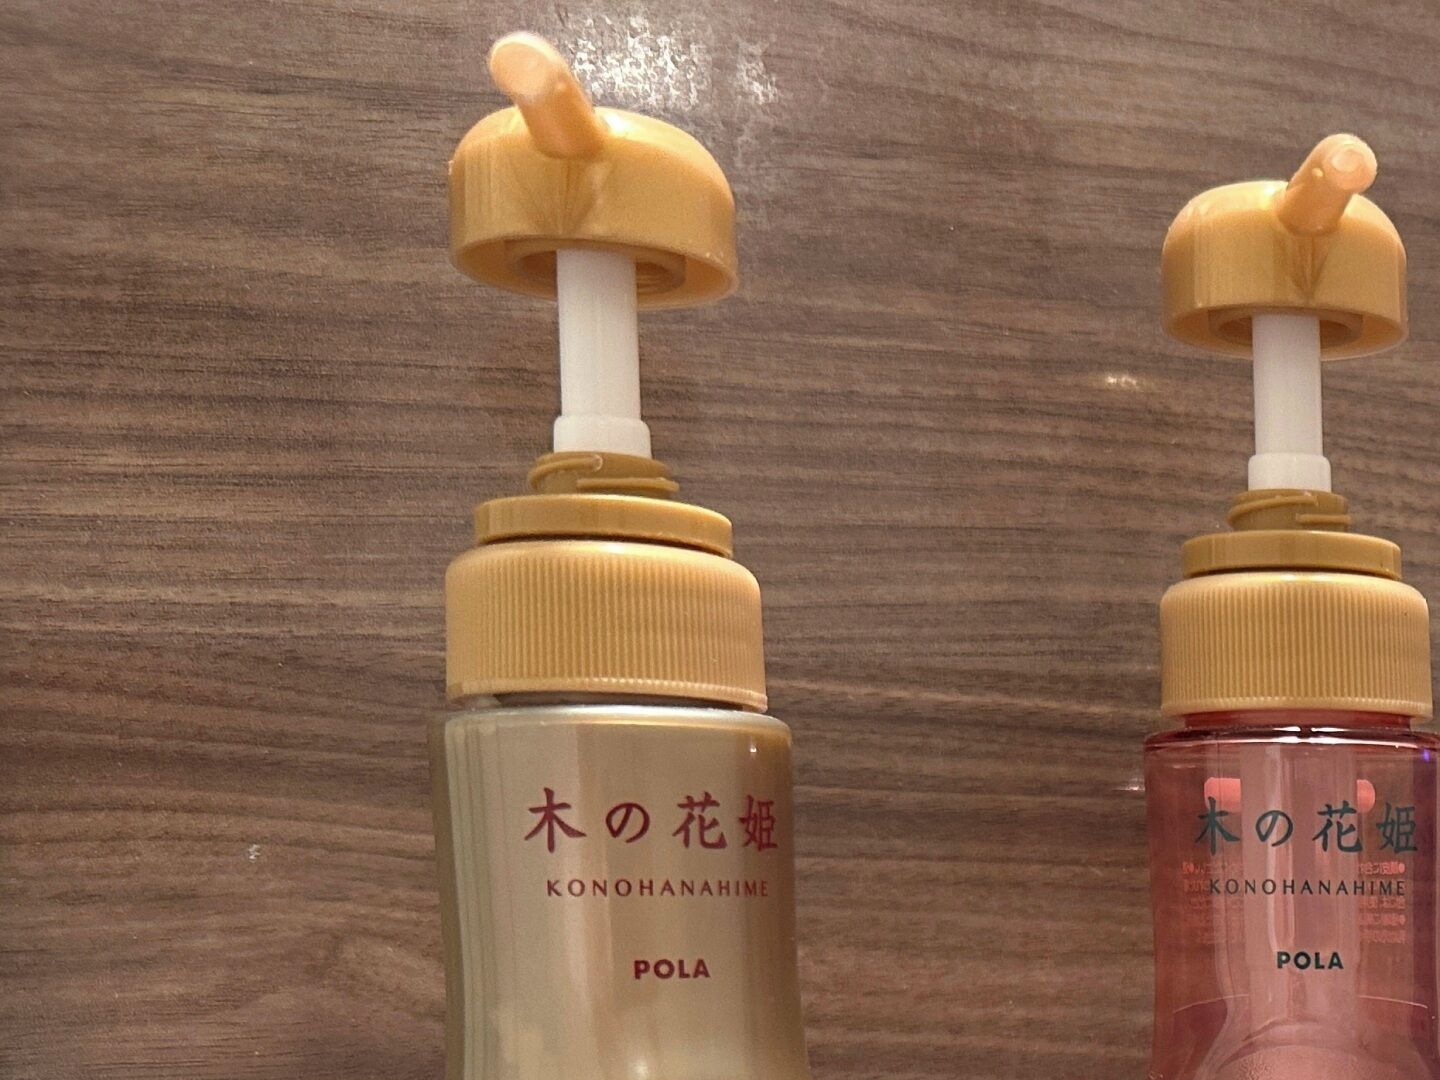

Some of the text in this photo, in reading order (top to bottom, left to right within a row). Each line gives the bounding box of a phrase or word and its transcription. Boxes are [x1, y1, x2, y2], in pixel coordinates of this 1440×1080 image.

[524, 787, 779, 853] 木の花姫
[1194, 796, 1418, 855] 木の花姫
[546, 878, 769, 898] KONOHANAHIME
[1208, 878, 1405, 897] KONOHANAHIME
[633, 958, 711, 980] POLA
[1276, 951, 1344, 970] POLA
